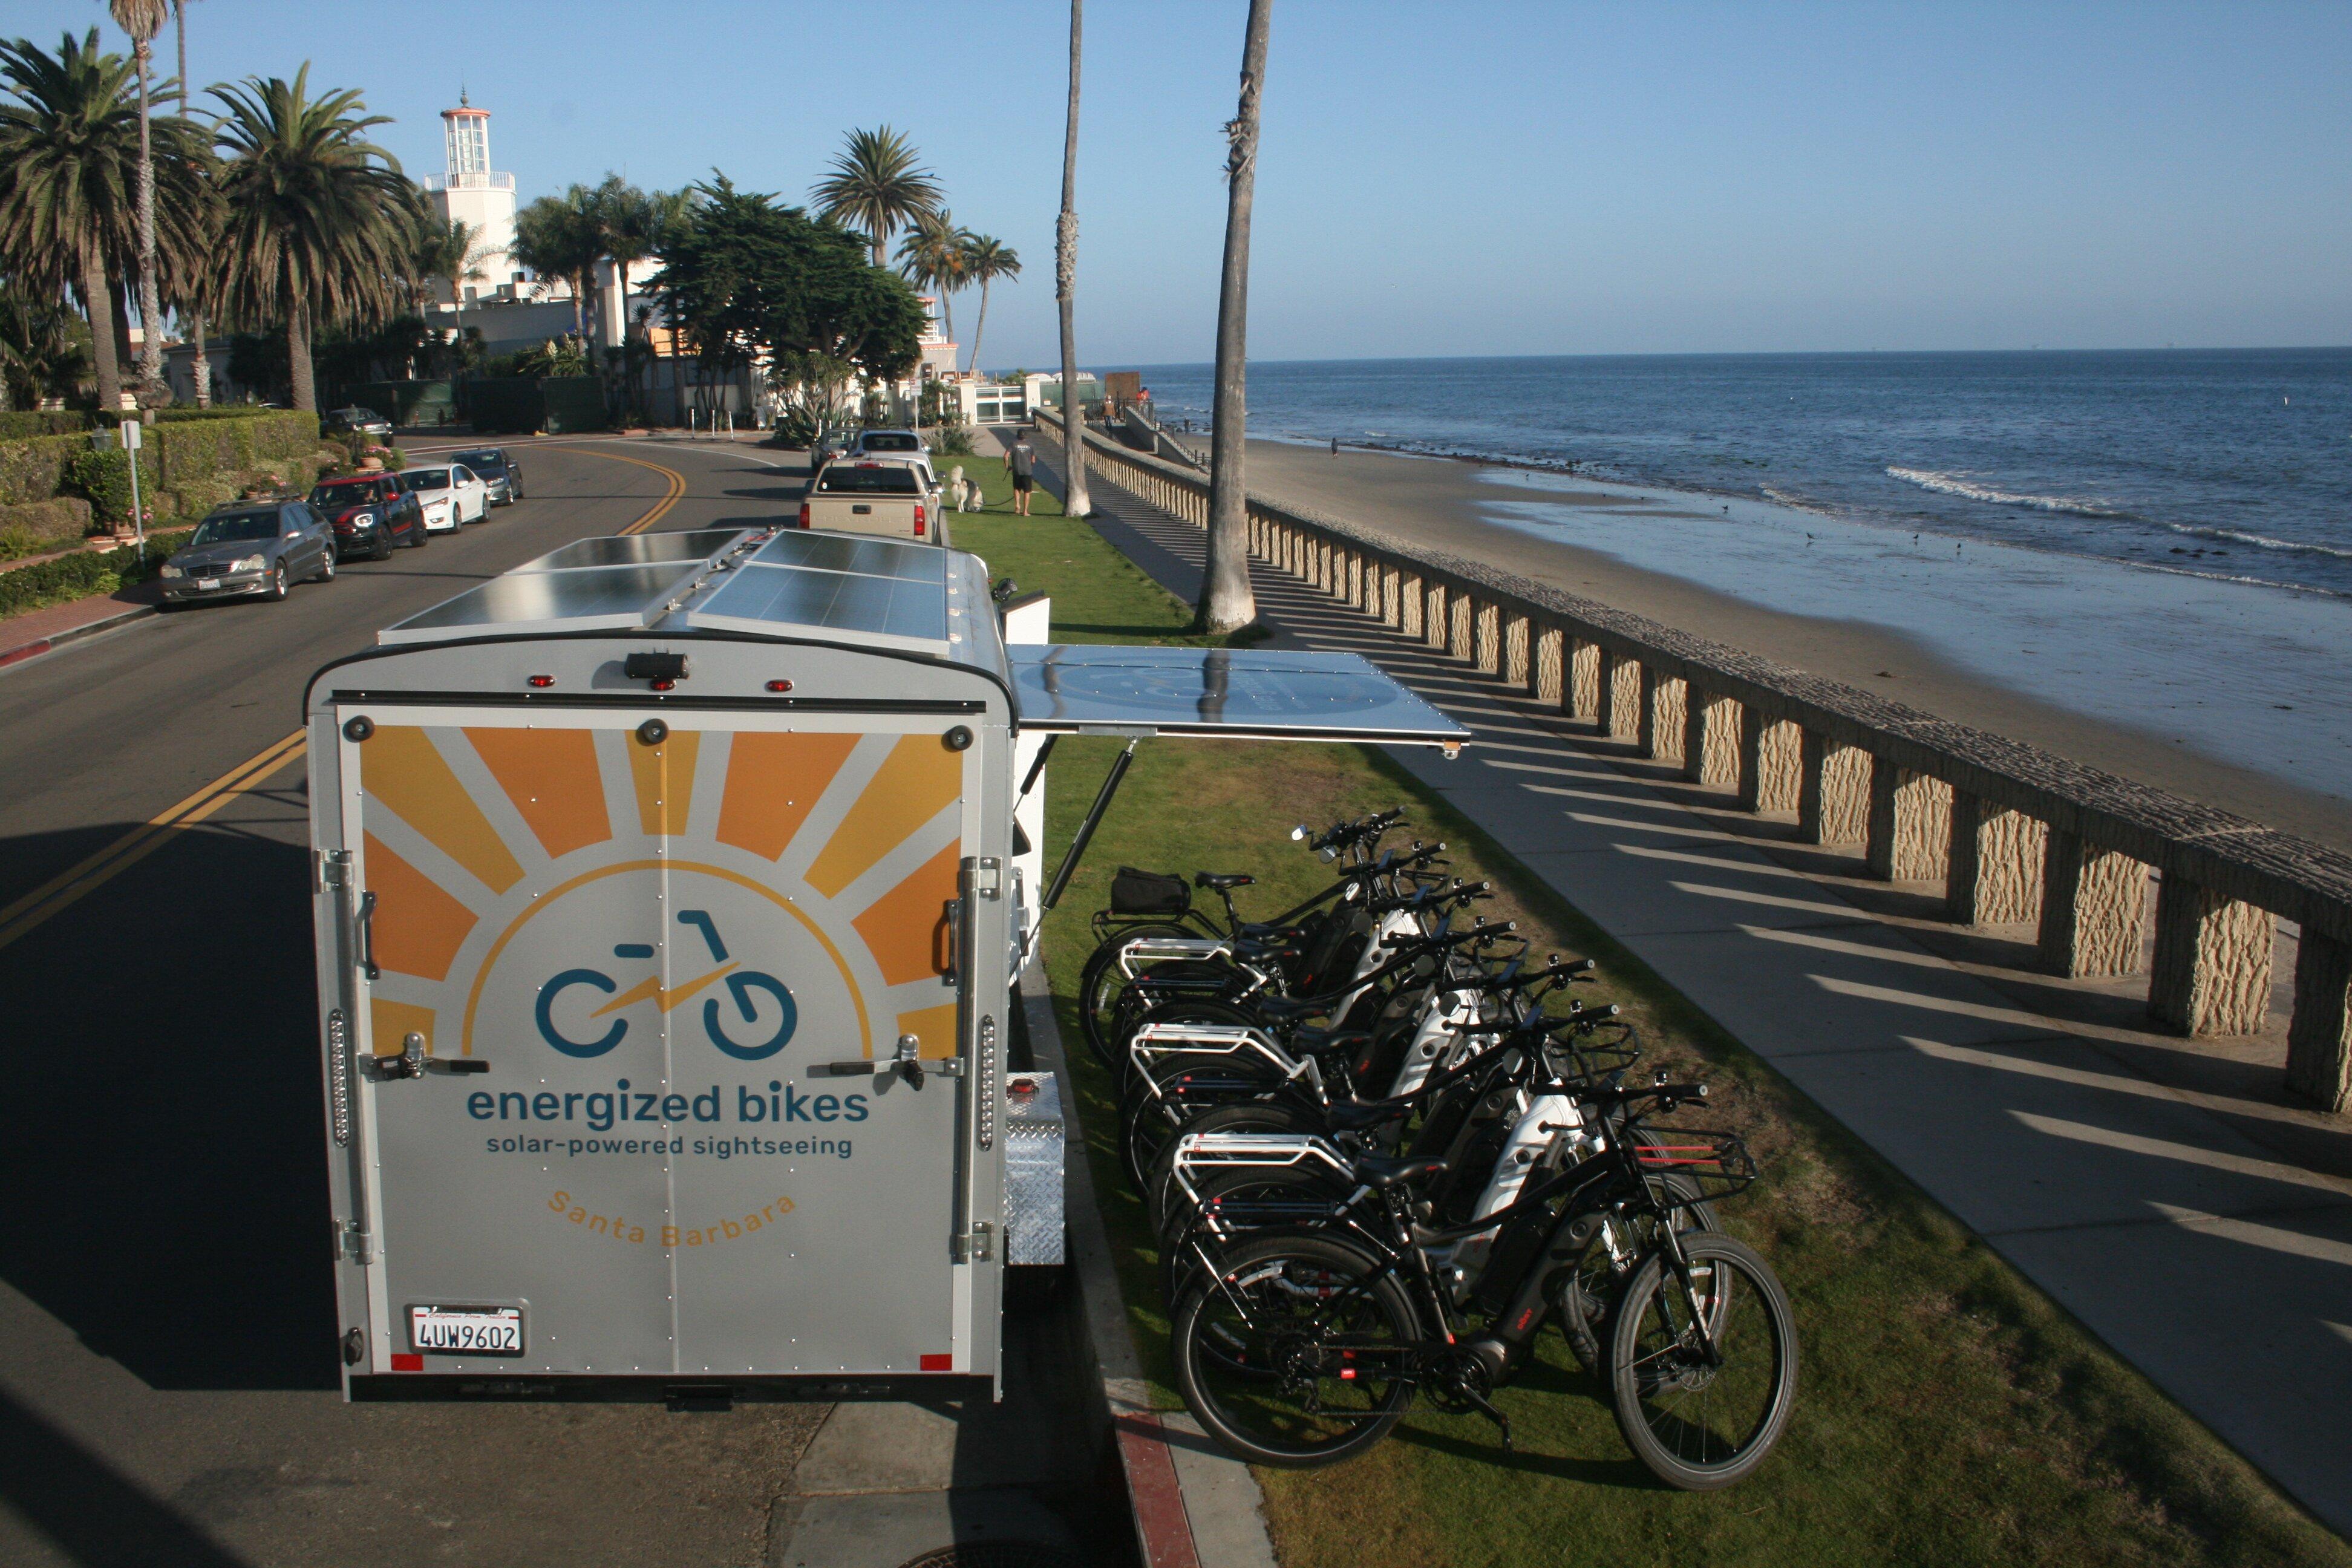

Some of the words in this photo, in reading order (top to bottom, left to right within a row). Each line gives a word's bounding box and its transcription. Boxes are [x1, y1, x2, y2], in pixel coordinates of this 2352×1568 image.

[468, 1079, 721, 1132] energized
[738, 1080, 869, 1123] bikes
[486, 1135, 684, 1157] solar-powered
[693, 1136, 853, 1159] sightseeing
[547, 1191, 645, 1244] Santa
[660, 1194, 797, 1247] Barbara
[420, 1323, 516, 1350] 4UW9602
